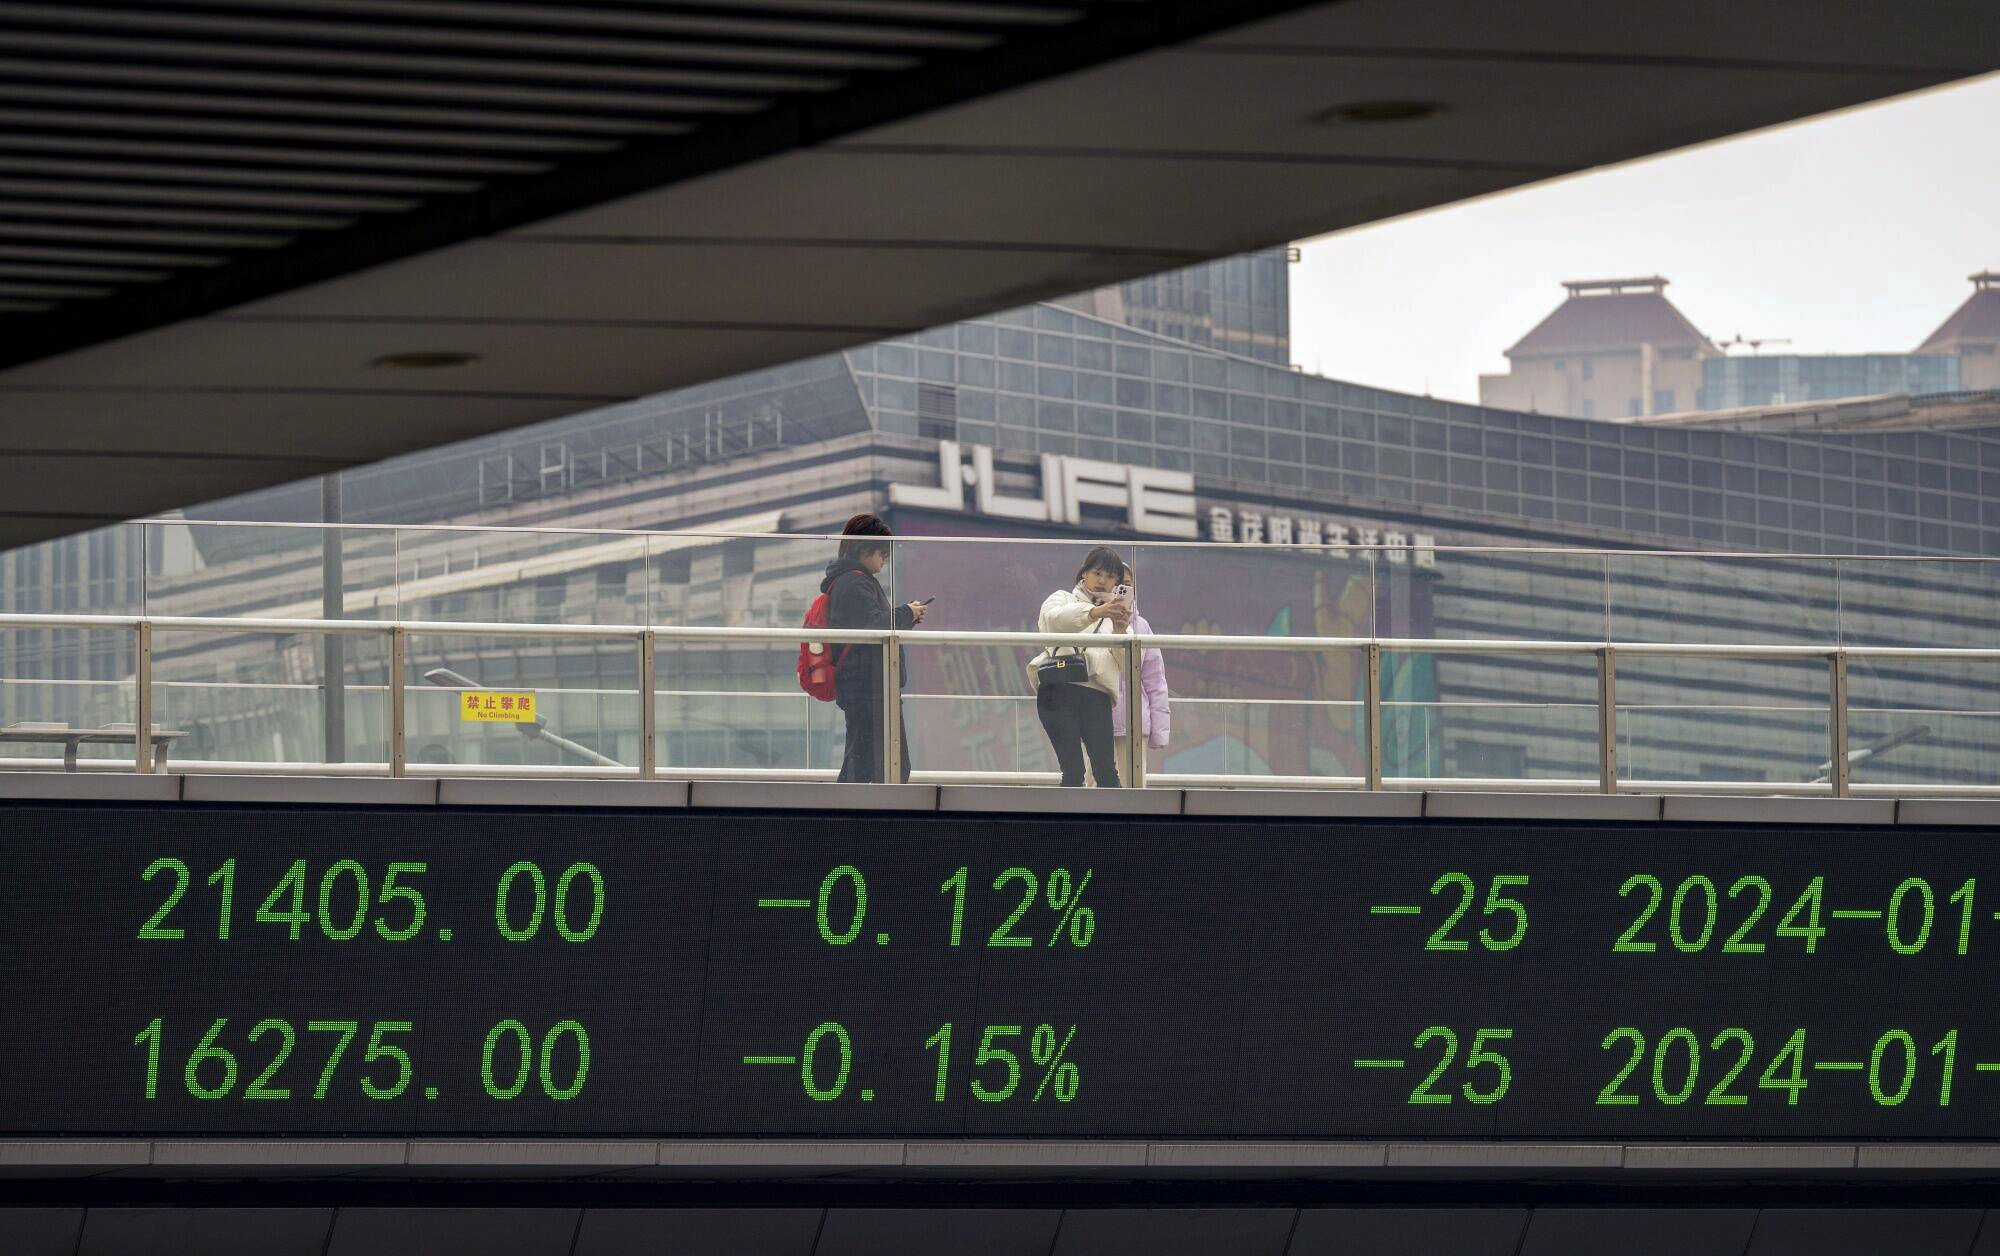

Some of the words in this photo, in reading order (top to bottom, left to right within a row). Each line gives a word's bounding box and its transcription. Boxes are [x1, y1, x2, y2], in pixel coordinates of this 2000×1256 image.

[467, 695, 531, 711] 禁止攀爬
[477, 711, 488, 719] No
[489, 712, 520, 720] Climbing
[1370, 871, 1530, 952] -25
[1613, 874, 2000, 956] 2024-01
[1355, 1026, 1514, 1105] -25
